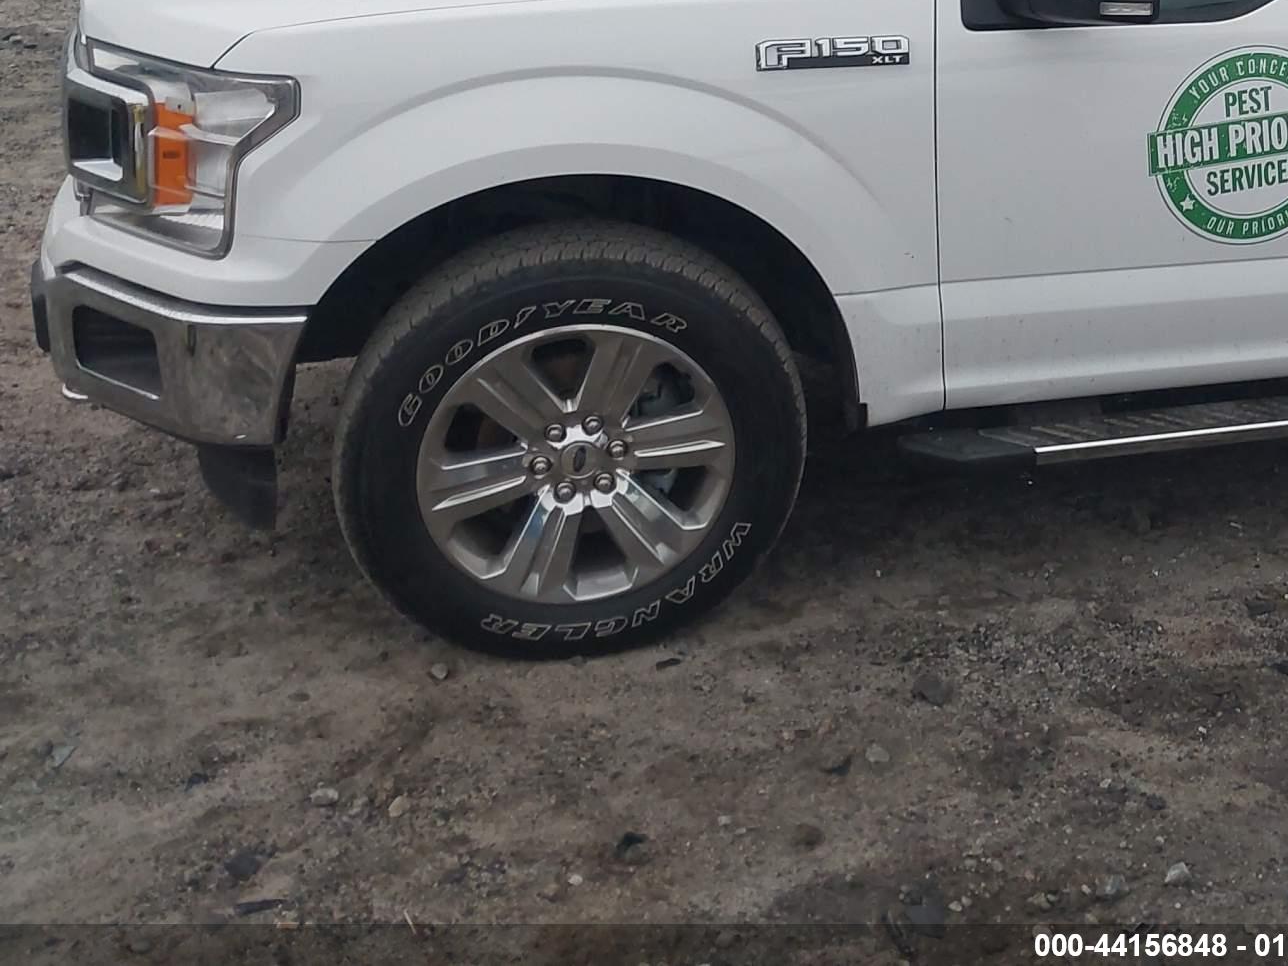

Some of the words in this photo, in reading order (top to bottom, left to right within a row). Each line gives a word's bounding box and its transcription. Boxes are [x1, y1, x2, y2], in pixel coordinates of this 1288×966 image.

[871, 54, 904, 65] XLT
[1188, 66, 1230, 101] YOUR
[1224, 85, 1273, 118] PEST
[1156, 126, 1220, 169] HIGH
[1206, 216, 1235, 236] OUR
[398, 298, 688, 427] GOODYEAR
[479, 522, 751, 642] WRANGLER
